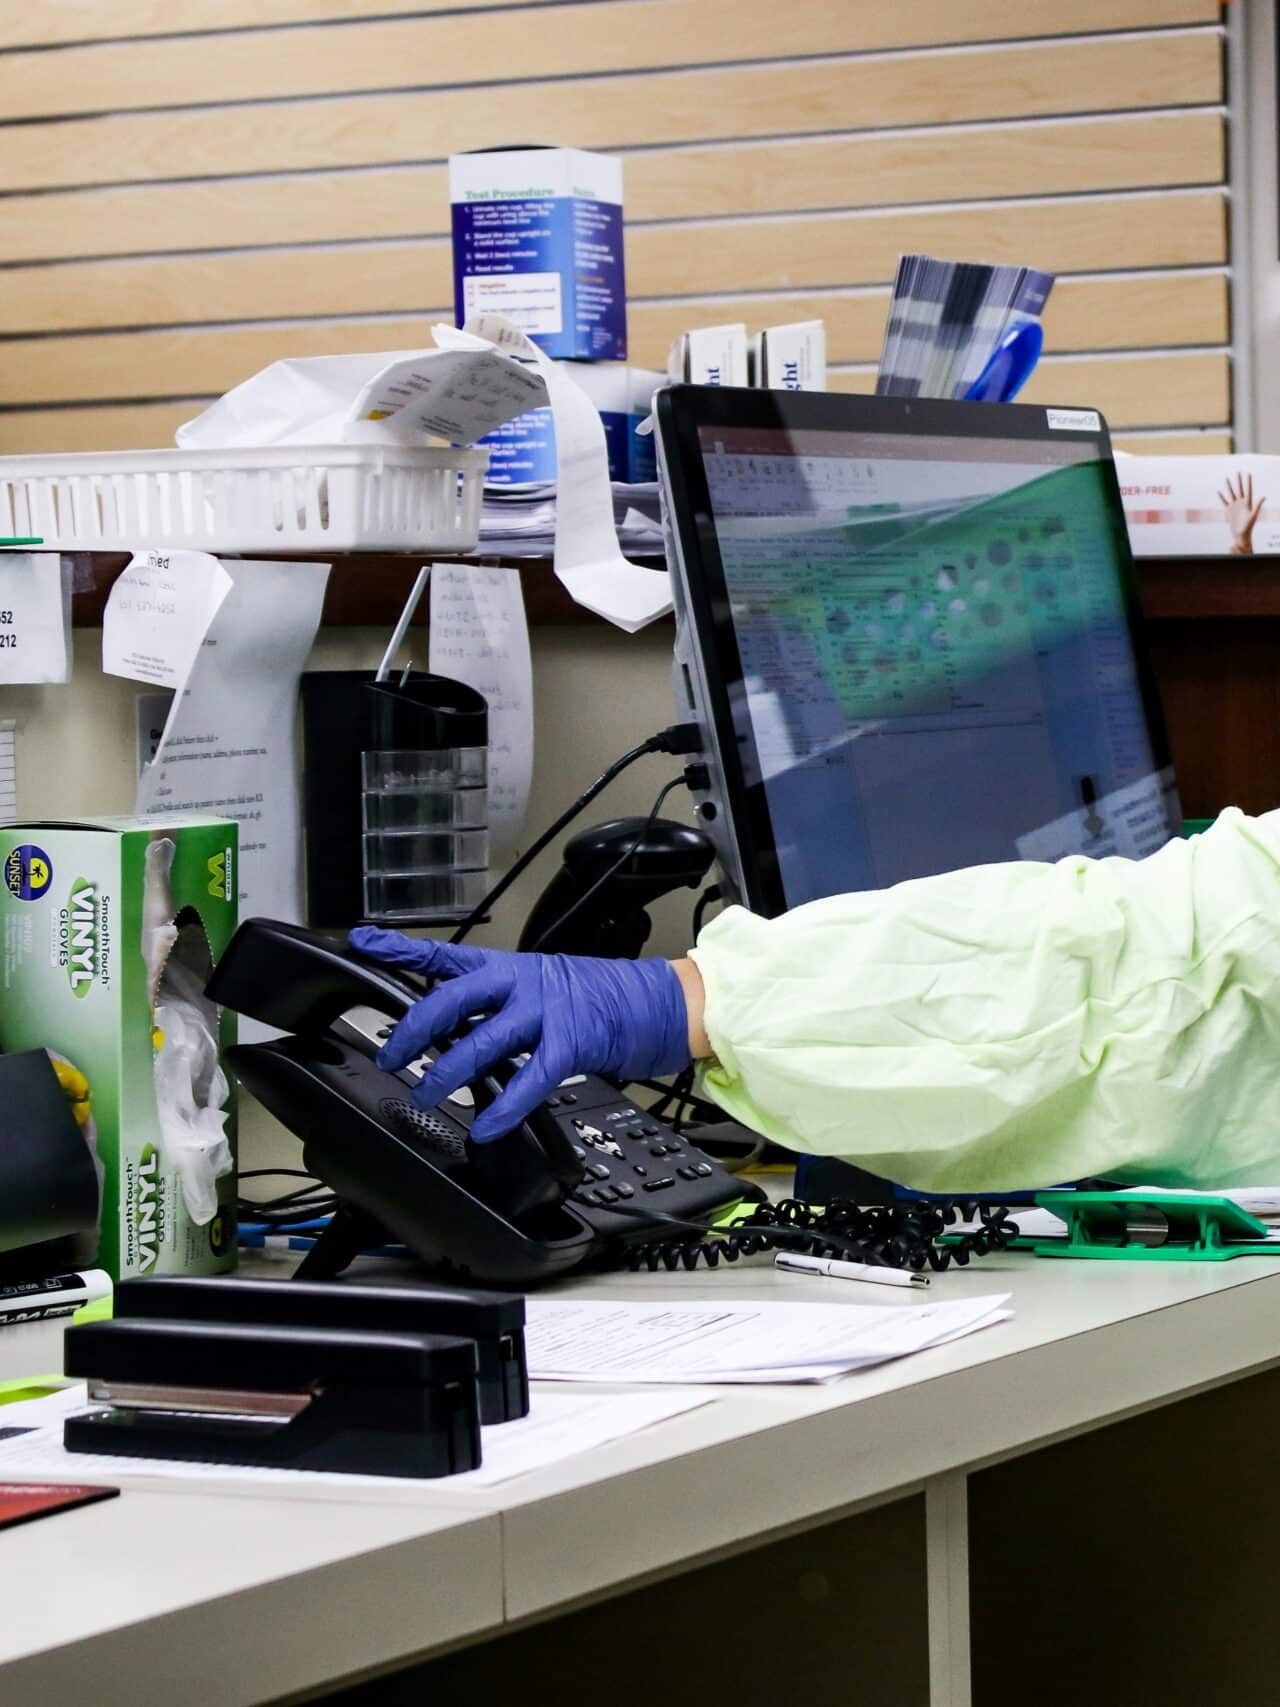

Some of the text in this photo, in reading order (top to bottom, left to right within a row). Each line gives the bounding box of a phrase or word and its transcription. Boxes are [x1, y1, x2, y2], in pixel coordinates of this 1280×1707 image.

[465, 187, 555, 200] Test Procedure
[9, 850, 22, 896] SUNSET
[59, 908, 69, 966] GLOVES
[71, 887, 95, 989] VINYL
[101, 895, 111, 985] SmoothTouch
[126, 1162, 134, 1267] SmoothTouch
[139, 1152, 157, 1273] VINYL
[158, 1177, 166, 1243] GLOVES
